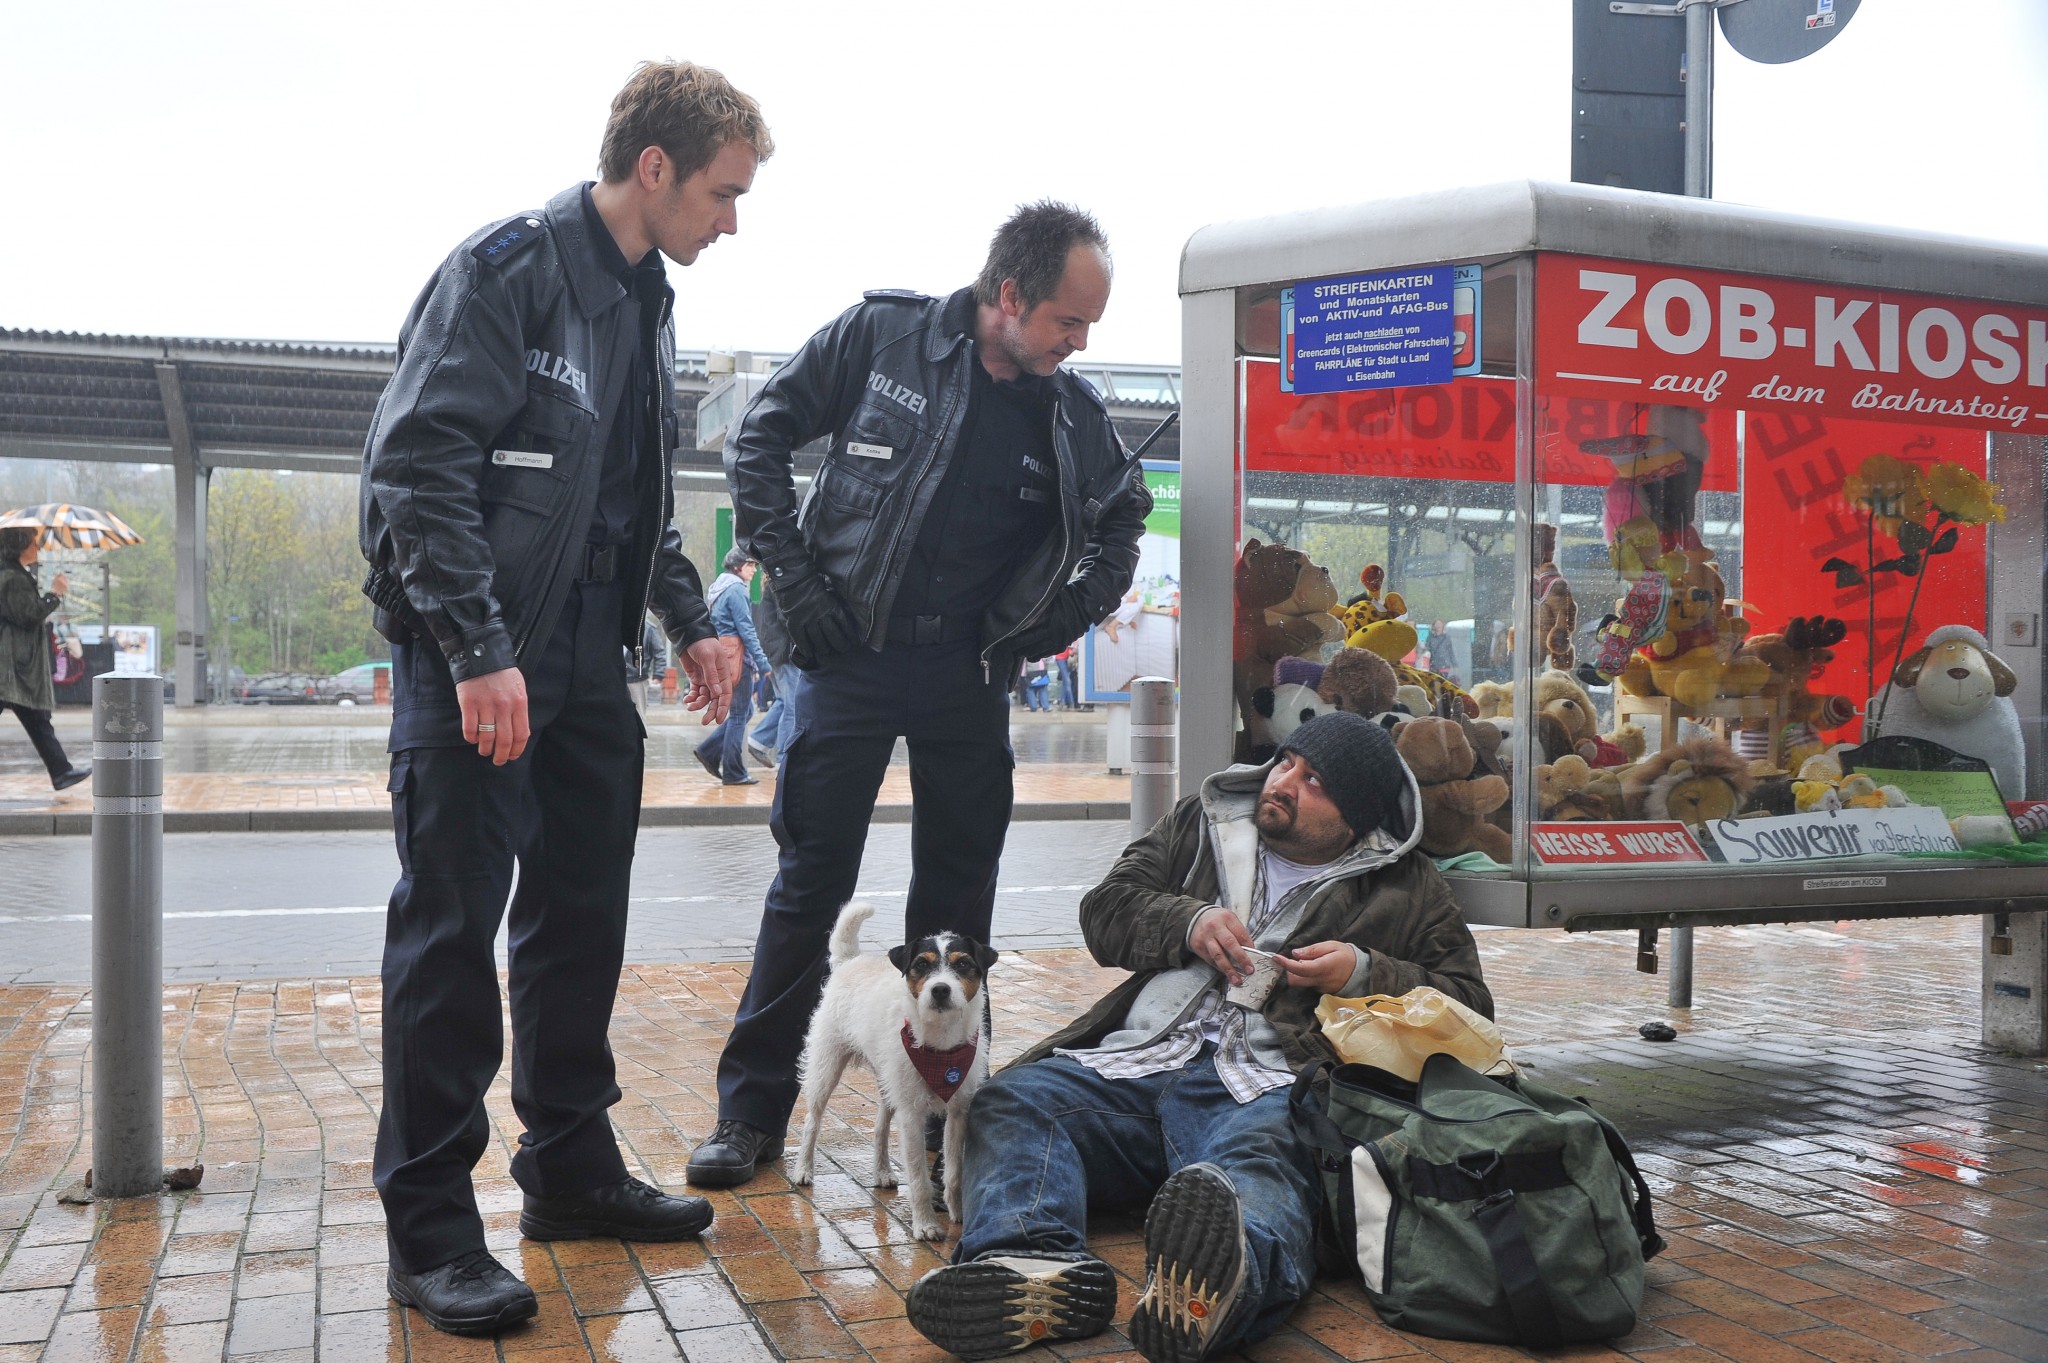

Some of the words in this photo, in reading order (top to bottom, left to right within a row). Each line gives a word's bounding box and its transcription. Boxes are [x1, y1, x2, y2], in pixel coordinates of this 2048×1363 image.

[1314, 275, 1433, 298] STREIFENKARTEN
[1319, 299, 1340, 310] und
[1347, 292, 1420, 307] Monatskarten
[1299, 315, 1319, 324] von
[1326, 307, 1383, 321] AKTIV-und
[1390, 301, 1449, 315] AFAG-Bus
[1325, 332, 1343, 344] jetzt
[1344, 330, 1363, 340] auch
[1364, 327, 1404, 339] nachladen
[1405, 326, 1420, 334] von
[1297, 346, 1341, 358] Greencards
[1346, 341, 1402, 354] Elektronischer
[1404, 336, 1450, 349] Fahrschein)
[524, 348, 586, 394] OLIZEI
[1315, 358, 1362, 370] FAHRPLÄNE
[1364, 357, 1375, 366] für
[1377, 354, 1399, 365] Stadt
[1409, 352, 1430, 362] Land
[1355, 370, 1396, 381] Eisenbahn
[865, 370, 928, 415] POLIZEI
[1650, 369, 1728, 402] auf
[1748, 375, 1824, 404] dem
[1852, 383, 2030, 428] Bahnsteig
[514, 456, 543, 464] Hoffmann
[1534, 832, 1616, 856] HEISSE
[1616, 831, 1694, 856] WURST
[1717, 809, 1862, 864] Souvenir
[1862, 877, 1884, 886] KIOSK
